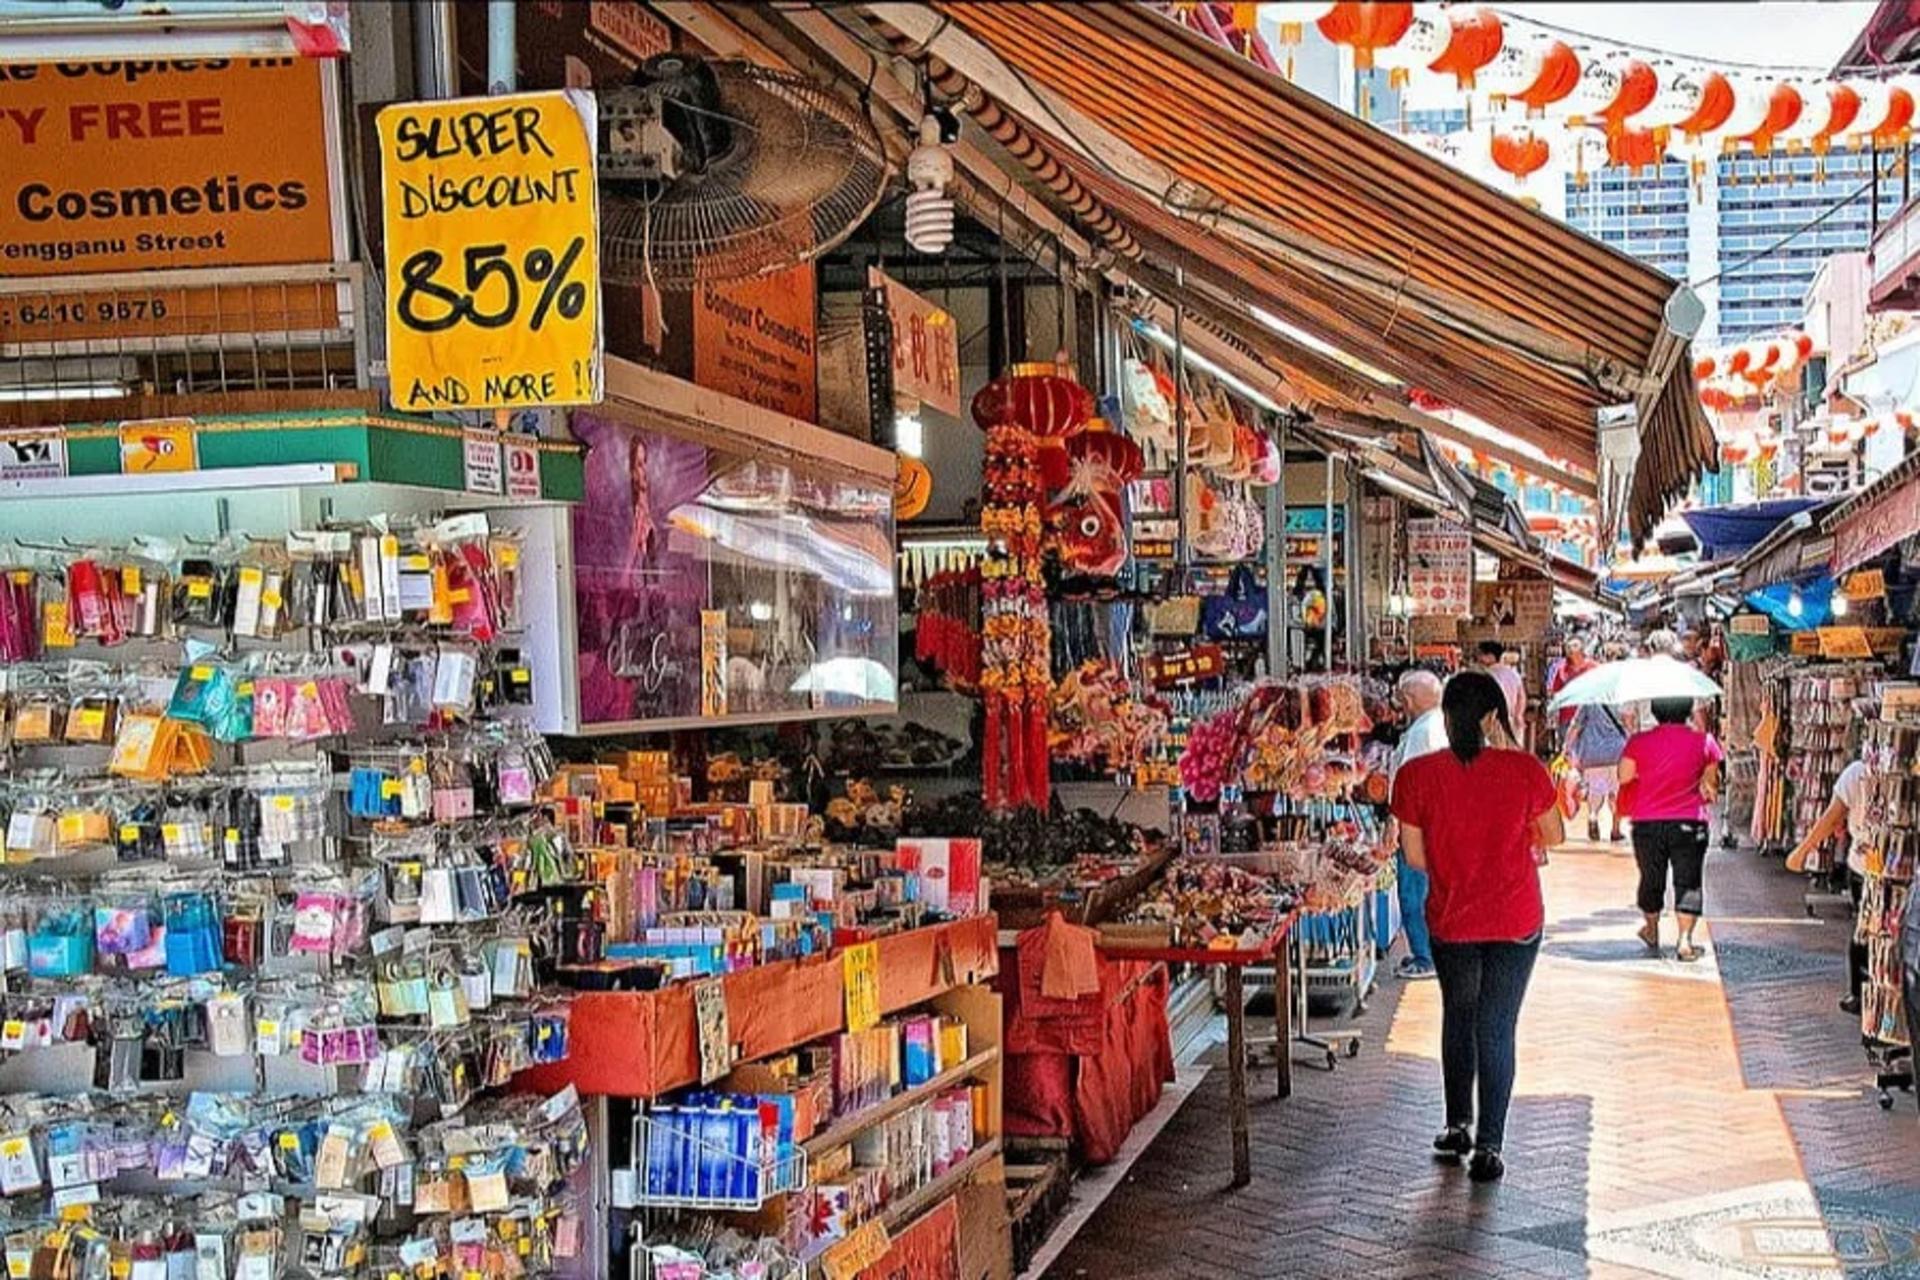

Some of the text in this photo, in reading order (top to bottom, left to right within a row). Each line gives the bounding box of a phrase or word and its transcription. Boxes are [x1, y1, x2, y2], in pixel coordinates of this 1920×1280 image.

[0, 98, 224, 144] Y FREE
[397, 107, 554, 163] SUPER
[17, 176, 308, 221] Cosmetics
[399, 169, 579, 219] DISCOUNT
[0, 231, 226, 261] engganu Street
[397, 236, 586, 332] 85%
[409, 376, 470, 406] AND
[484, 371, 556, 403] MORE
